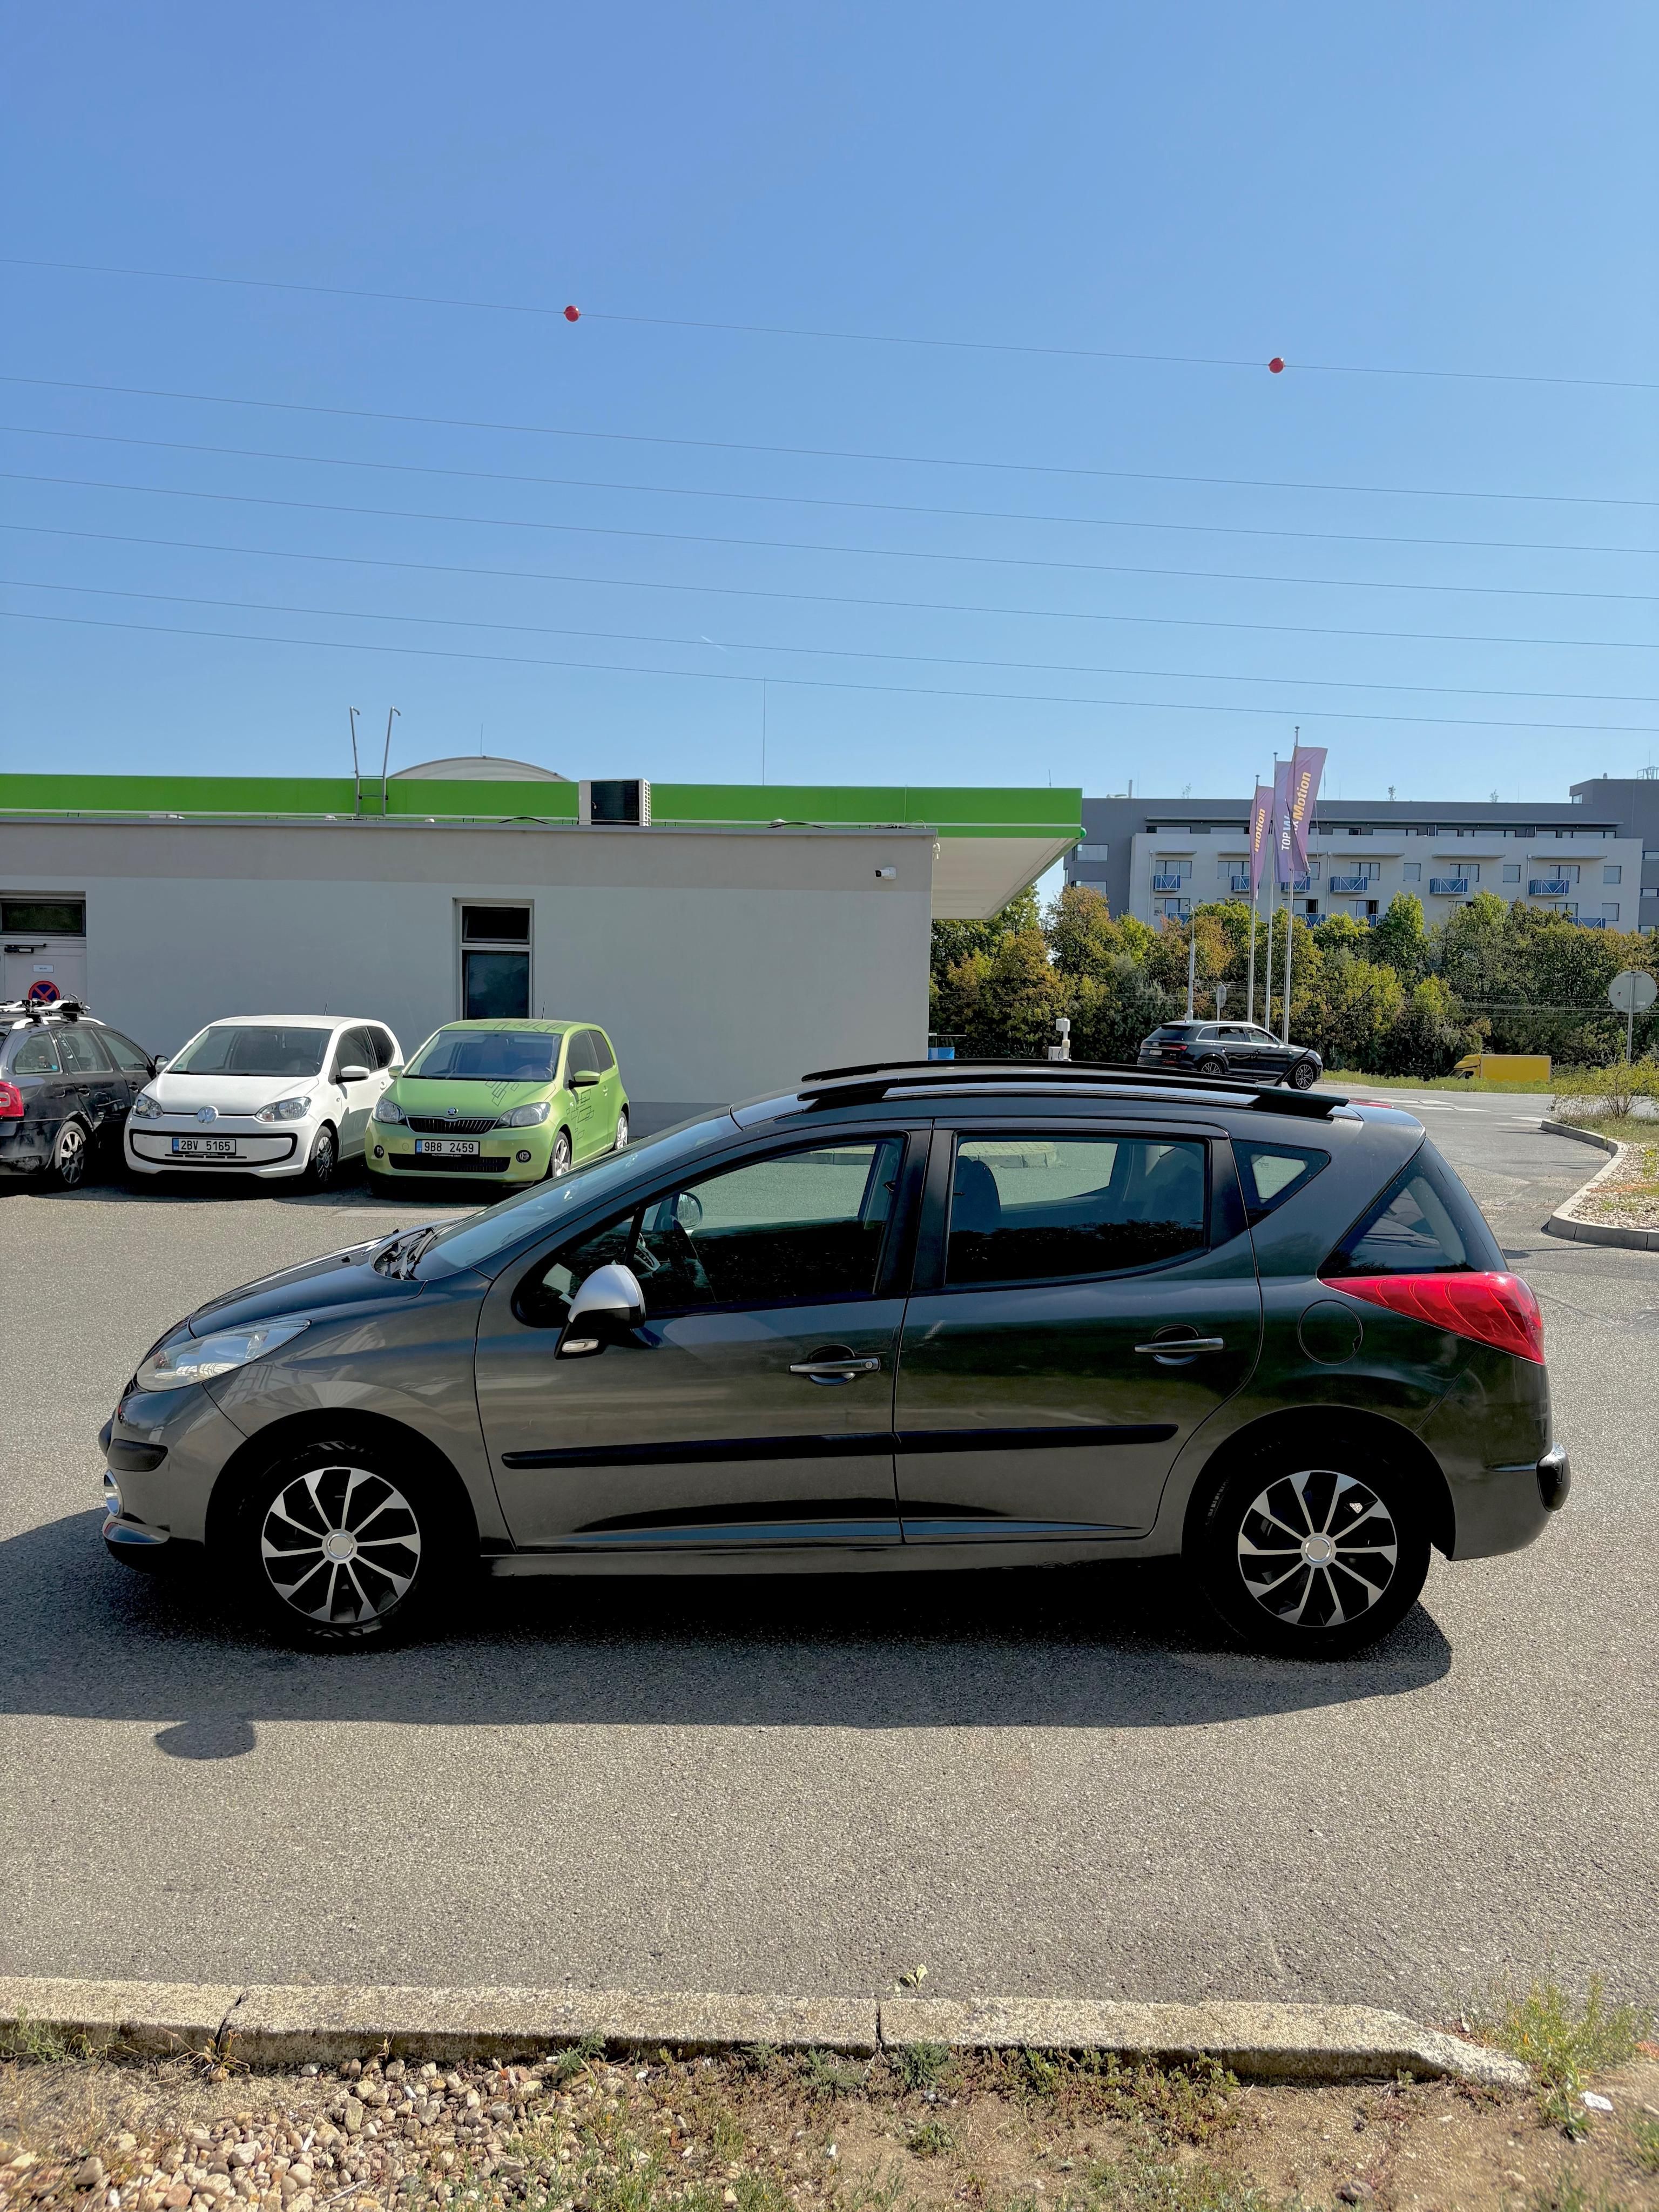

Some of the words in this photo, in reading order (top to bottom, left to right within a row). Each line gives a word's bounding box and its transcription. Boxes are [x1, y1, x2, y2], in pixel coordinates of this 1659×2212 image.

[1281, 832, 1291, 851] TOP
[181, 1140, 198, 1150] 2BV
[206, 1141, 231, 1151] 5165
[424, 1142, 442, 1152] 9B8
[449, 1143, 474, 1153] 2459
